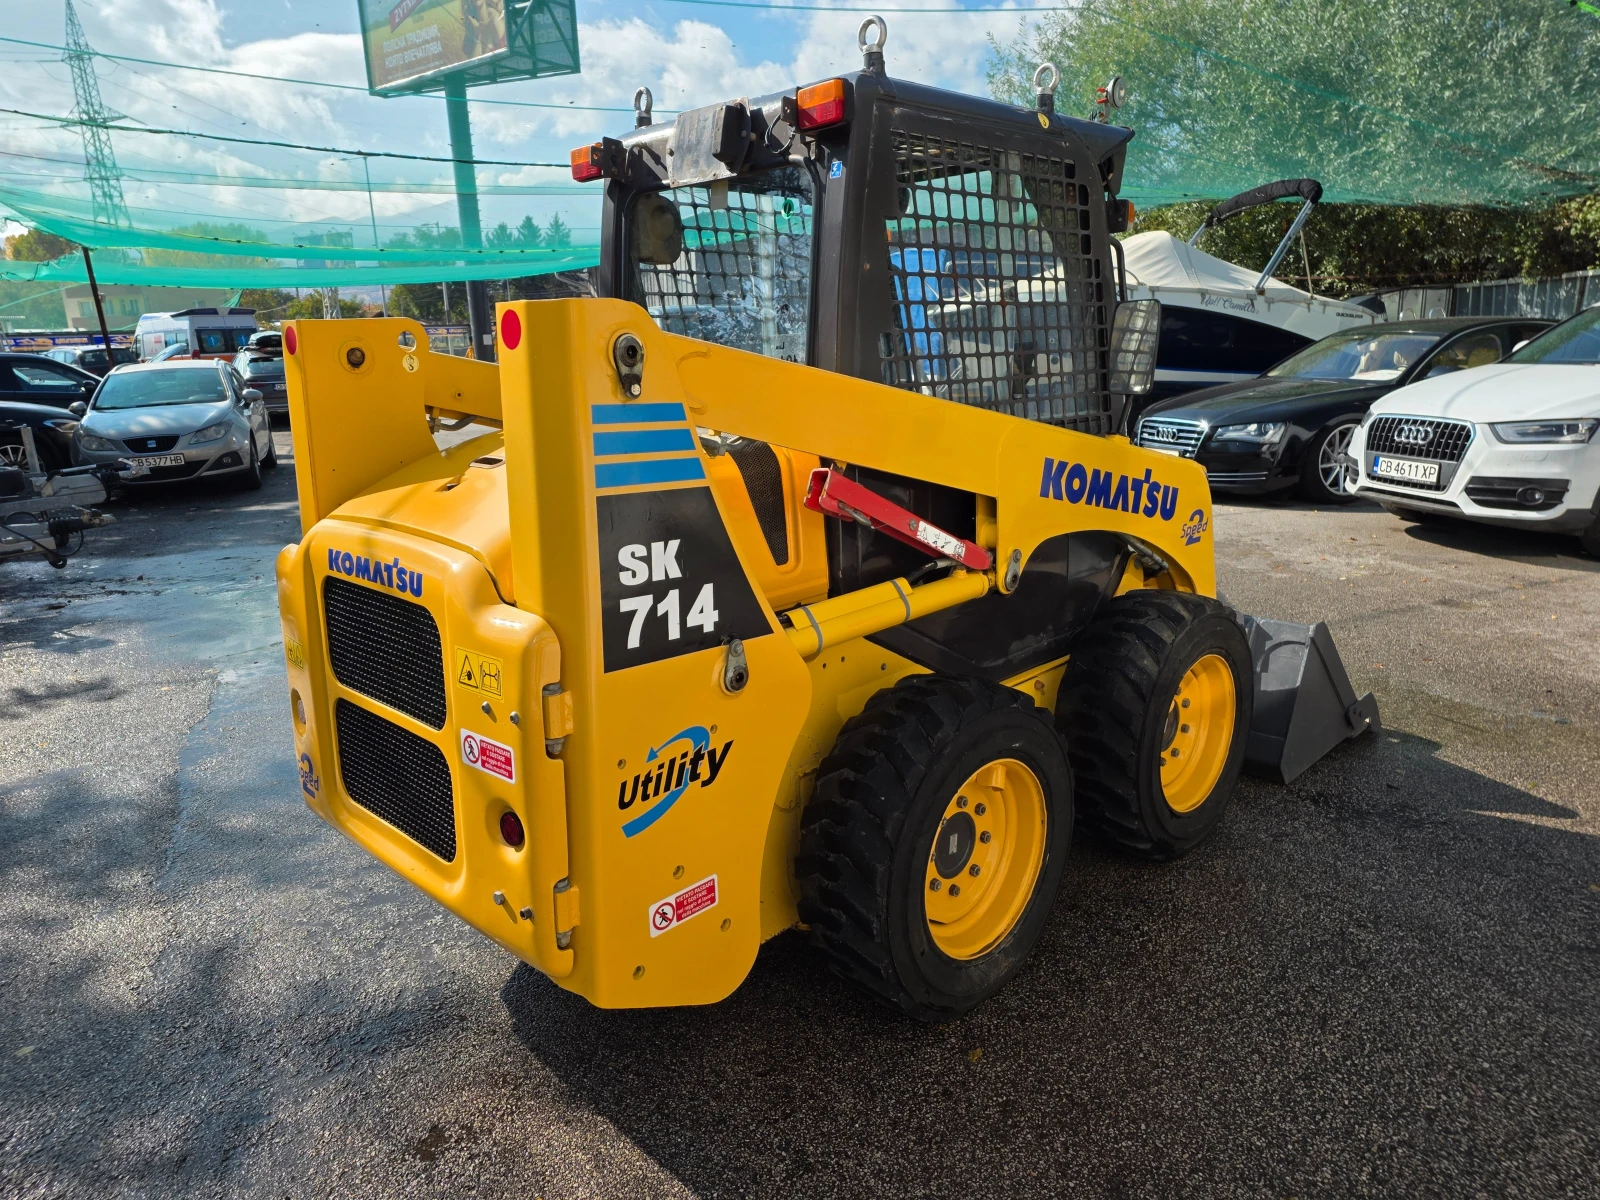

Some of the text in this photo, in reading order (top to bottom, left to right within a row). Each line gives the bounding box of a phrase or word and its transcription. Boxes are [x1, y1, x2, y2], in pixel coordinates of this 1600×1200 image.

[145, 456, 168, 467] 5377
[170, 455, 183, 465] HB
[1380, 459, 1392, 474] CB
[1394, 462, 1418, 478] 4611
[1422, 465, 1437, 480] XP
[1039, 457, 1179, 521] KOMATSU
[1180, 517, 1208, 539] Speed
[328, 548, 423, 598] KOMATSU
[618, 539, 682, 586] SK
[620, 582, 719, 650] 714
[677, 880, 713, 903] VIETATO PASSARE
[688, 890, 707, 904] SOSTARE
